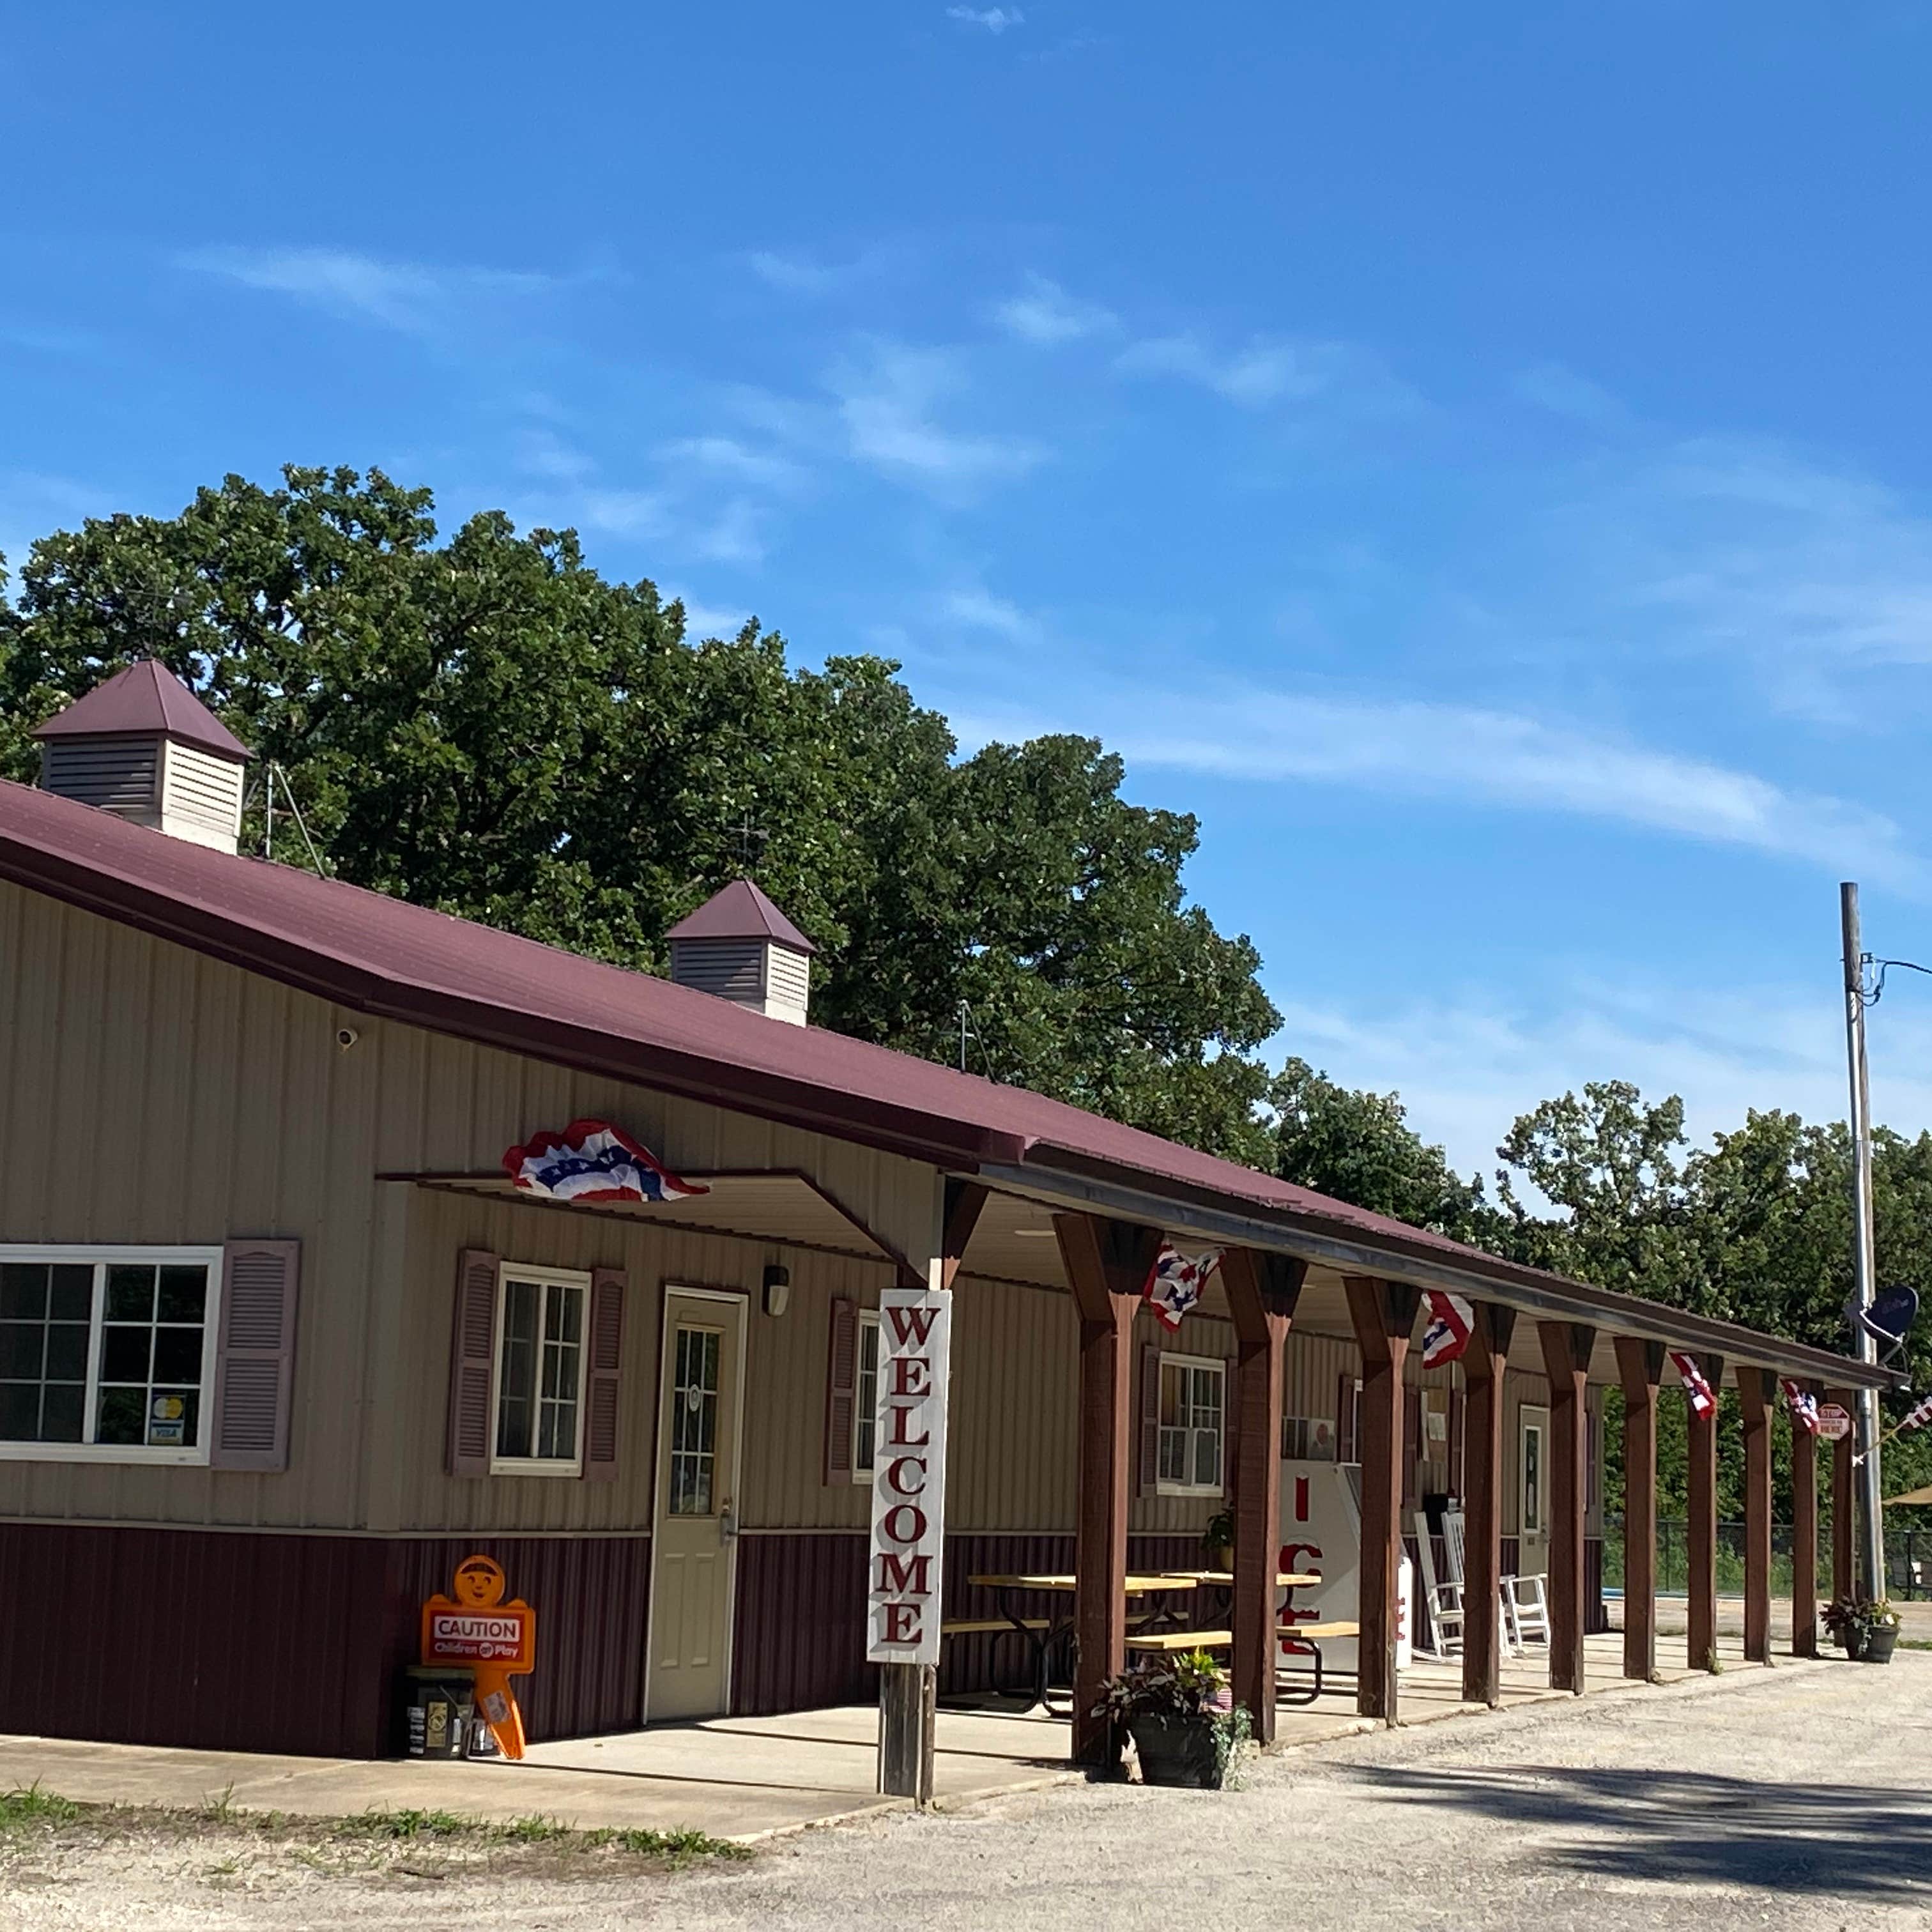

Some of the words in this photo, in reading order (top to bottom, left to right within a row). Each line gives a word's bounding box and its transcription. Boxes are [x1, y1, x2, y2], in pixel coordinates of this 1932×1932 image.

[157, 1428, 177, 1437] VISA
[876, 1306, 941, 1644] WELCOME
[438, 1620, 516, 1638] CAUTION
[494, 1644, 518, 1659] Play
